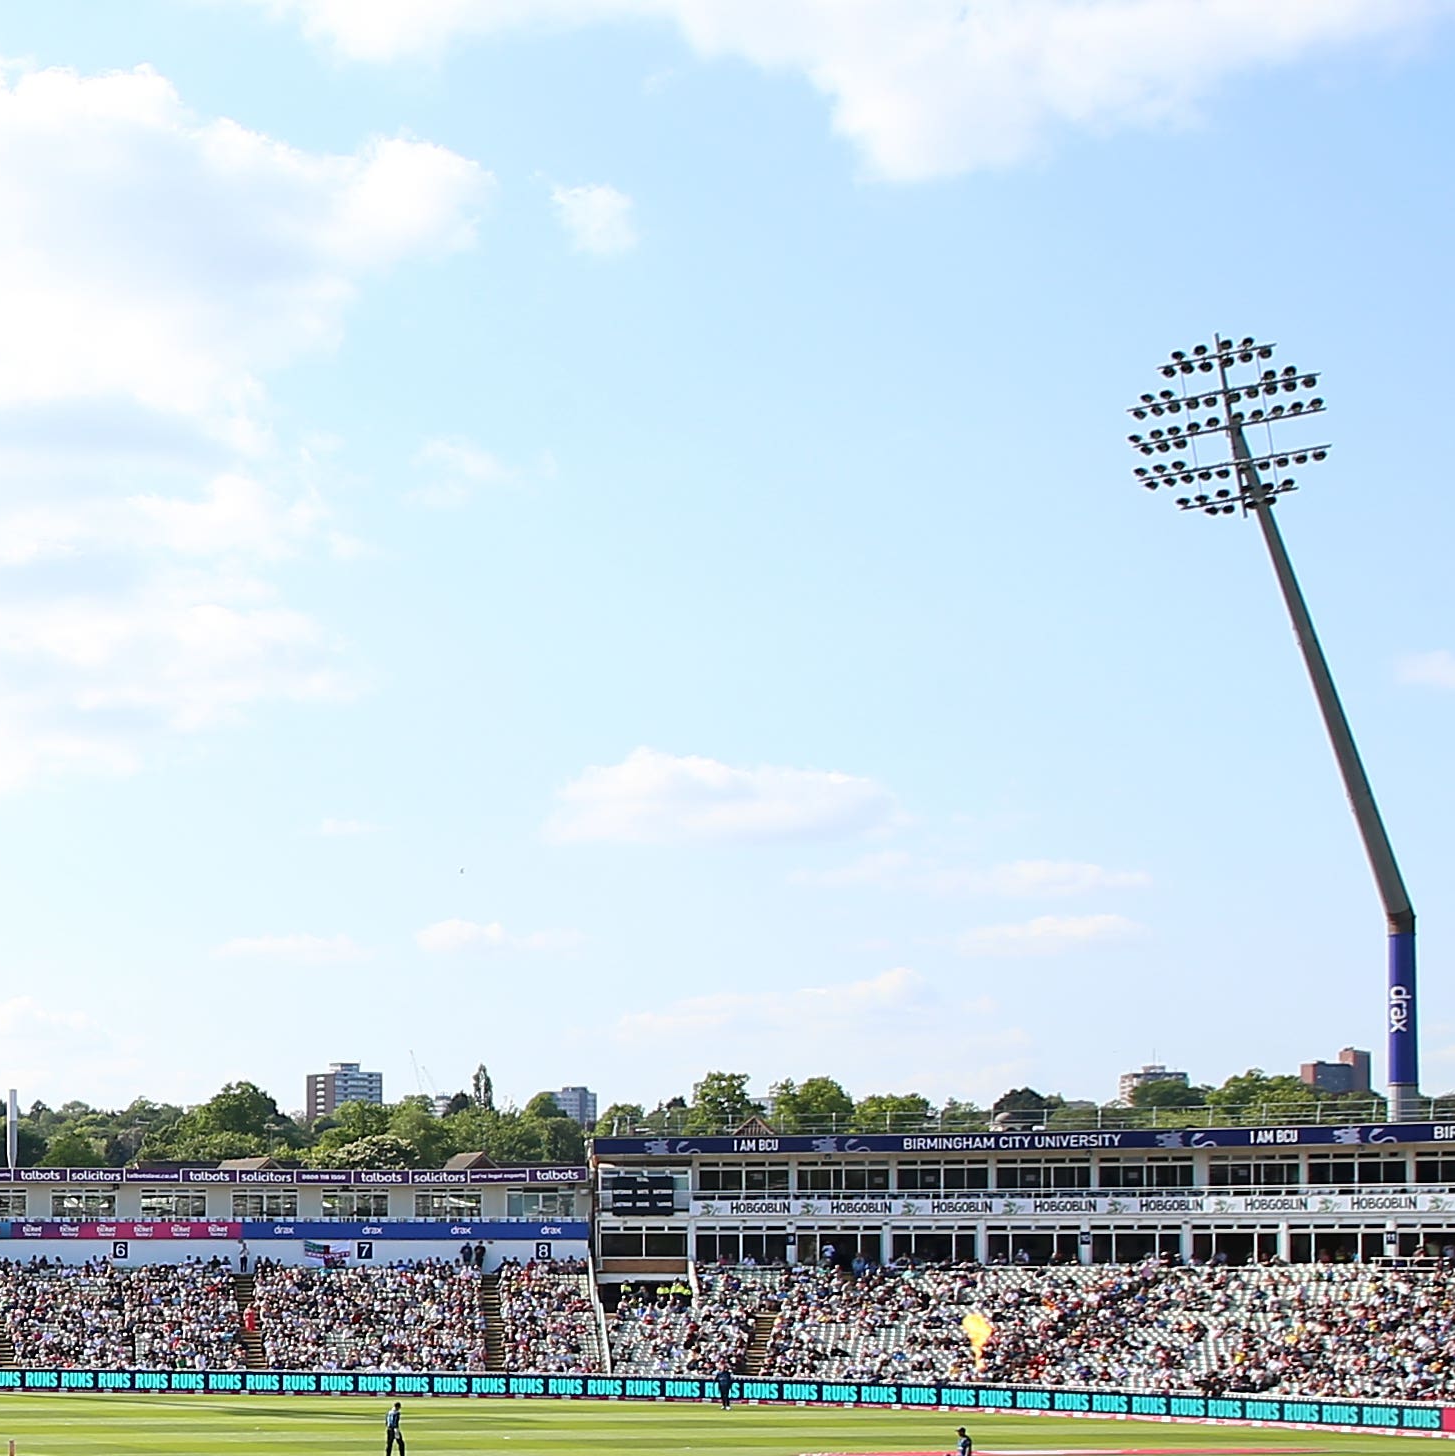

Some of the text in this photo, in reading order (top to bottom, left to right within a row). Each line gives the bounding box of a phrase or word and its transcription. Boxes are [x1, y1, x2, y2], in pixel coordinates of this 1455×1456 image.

[1390, 985, 1413, 1033] drax
[903, 1133, 1121, 1151] BIRMINGHAM CITY UNIVERSITY
[1255, 1131, 1274, 1144] AM
[1276, 1130, 1298, 1144] BCU
[740, 1139, 757, 1151] AM
[759, 1138, 779, 1151] BCU
[20, 1170, 61, 1181] talbots
[71, 1170, 122, 1181] solicitors
[189, 1170, 230, 1182] talbots
[241, 1171, 292, 1182] solicitors
[361, 1171, 403, 1183] talbots
[413, 1171, 466, 1183] solicitors
[536, 1169, 579, 1181] talbots
[730, 1196, 1418, 1215] HOBGOBLIN HOBGOBLIN HOBGOBLIN HOBGOBLIN HOBGOBLIN HOBGOBLIN HOBGOBLIN
[273, 1225, 563, 1236] drax drax drax drax
[116, 1243, 126, 1256] 6
[360, 1244, 369, 1256] 7
[539, 1244, 549, 1258] 8
[98, 1372, 132, 1389] RUNS
[321, 1375, 354, 1391] RUNS
[549, 1378, 584, 1395] RUNS
[783, 1383, 818, 1401] RUNS
[902, 1386, 938, 1404] RUNS
[1017, 1391, 1051, 1409] RUNS
